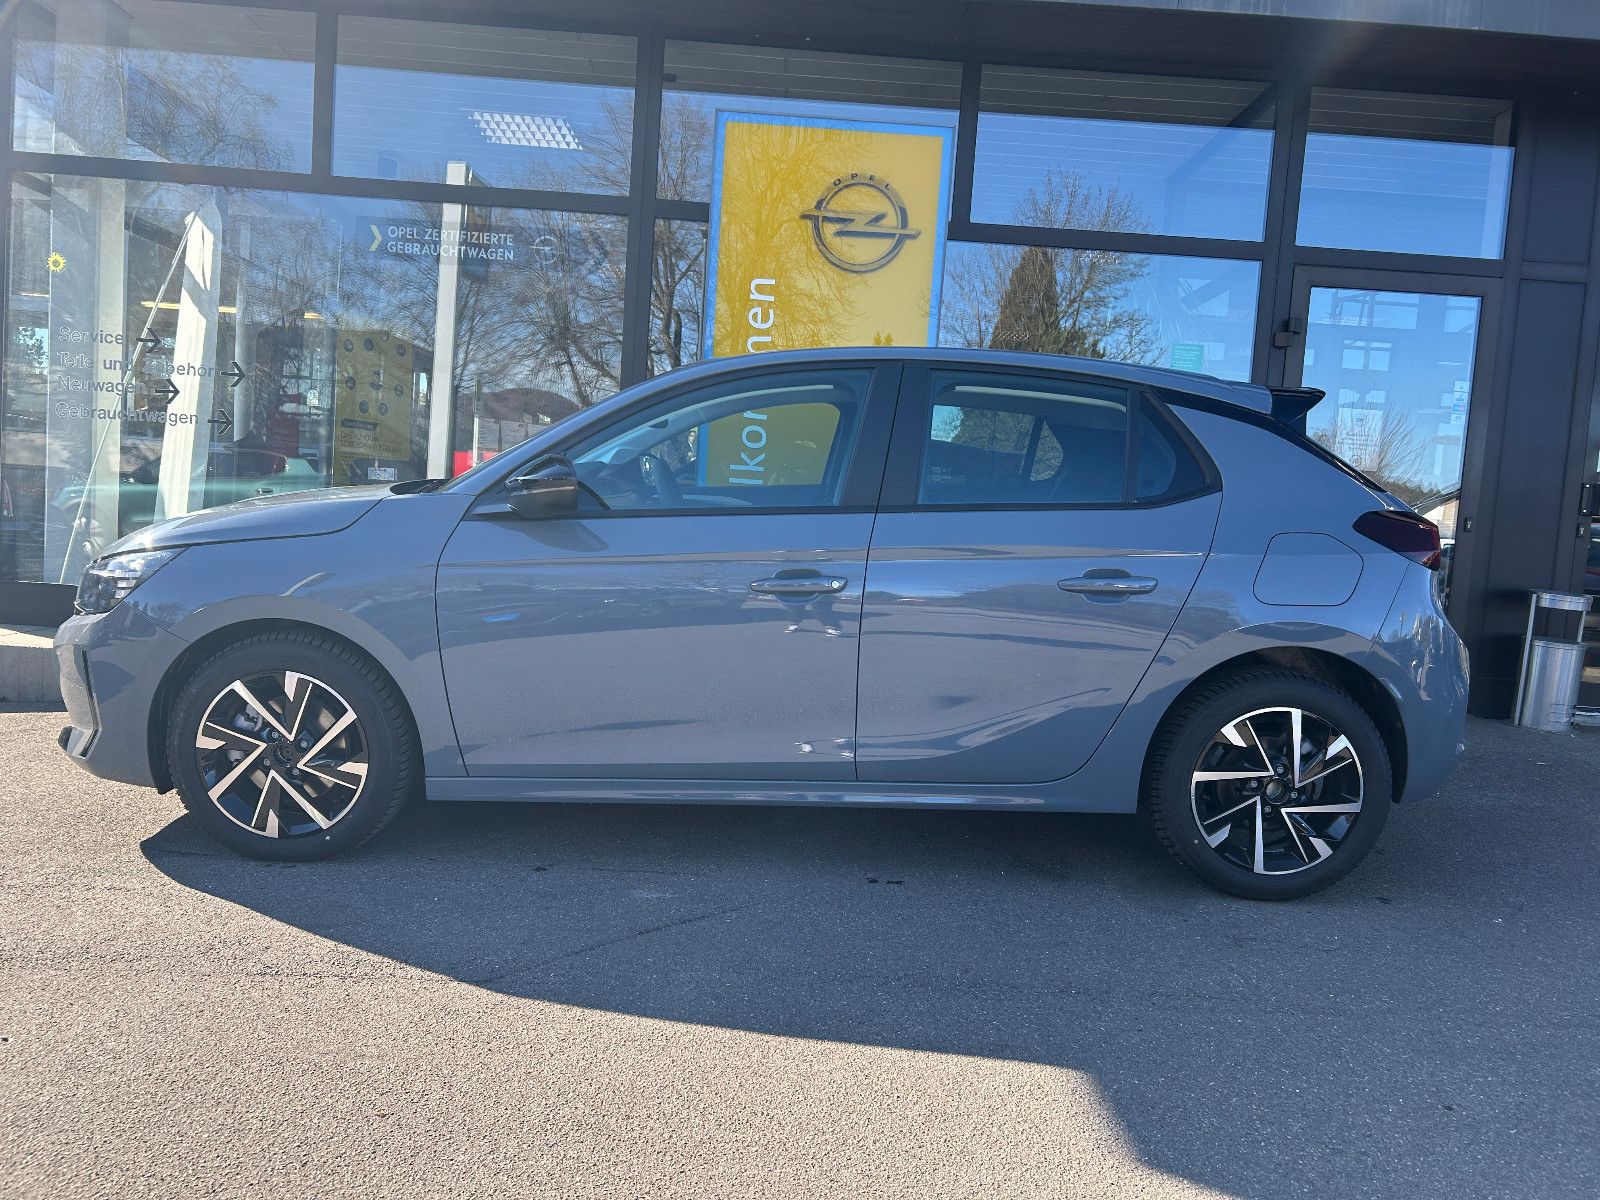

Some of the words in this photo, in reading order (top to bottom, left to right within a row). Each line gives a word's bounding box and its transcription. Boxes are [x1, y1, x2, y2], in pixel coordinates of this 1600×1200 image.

[833, 173, 891, 190] OPEL
[387, 226, 420, 240] OPEL
[425, 228, 514, 246] ZERTIFIZIERTE
[387, 241, 514, 261] GEBRAUCHTWAGEN
[58, 326, 124, 345] Service
[57, 351, 95, 369] Teile
[57, 375, 147, 396] Neuwagen
[55, 402, 199, 426] Gebrauchtwagen
